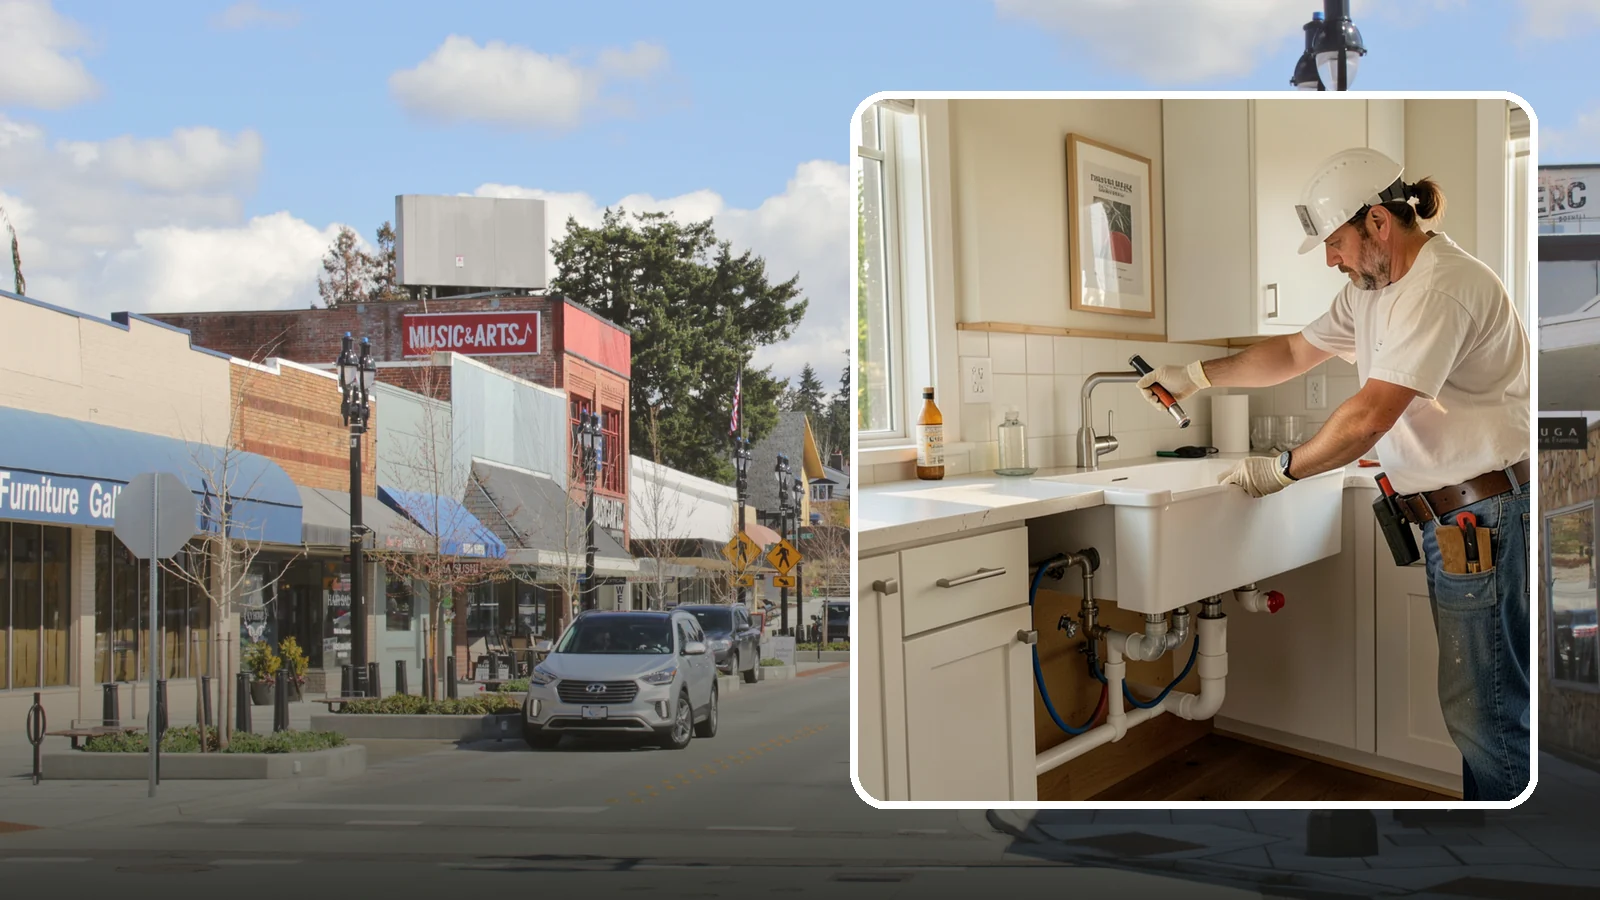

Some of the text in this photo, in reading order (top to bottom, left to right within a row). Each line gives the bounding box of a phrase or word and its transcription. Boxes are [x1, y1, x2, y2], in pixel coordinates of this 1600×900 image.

[408, 323, 519, 349] MUSIC&ARTS
[0, 471, 122, 519] Furniture Gal
